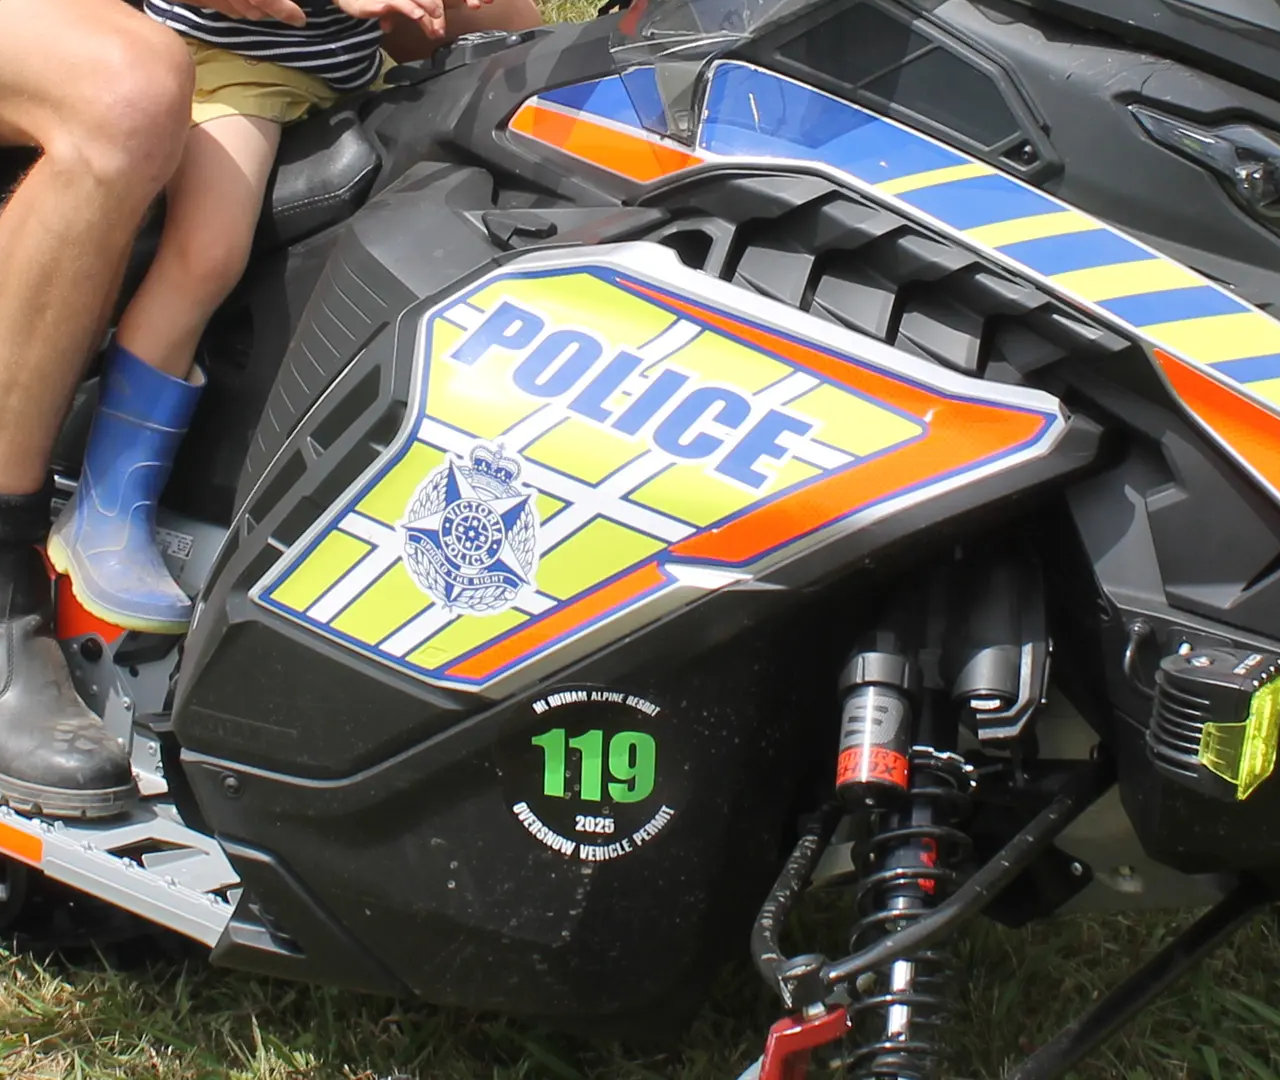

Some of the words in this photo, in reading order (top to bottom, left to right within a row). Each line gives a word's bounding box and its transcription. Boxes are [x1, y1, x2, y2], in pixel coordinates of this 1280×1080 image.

[450, 300, 814, 490] POLICE
[445, 499, 503, 541] VICTORIA
[419, 538, 449, 573] UPHOLD
[450, 572, 470, 586] THE
[472, 575, 505, 586] RIGHT
[442, 535, 492, 567] POLICE
[547, 691, 588, 709] HOTHAM
[591, 691, 625, 704] ALPINE
[625, 694, 662, 718] RESORT
[531, 728, 656, 804] 119
[512, 800, 578, 857] OVERSNOW
[578, 836, 634, 862] VEHICLE
[632, 804, 676, 847] PERMIT
[575, 814, 616, 835] 2025
